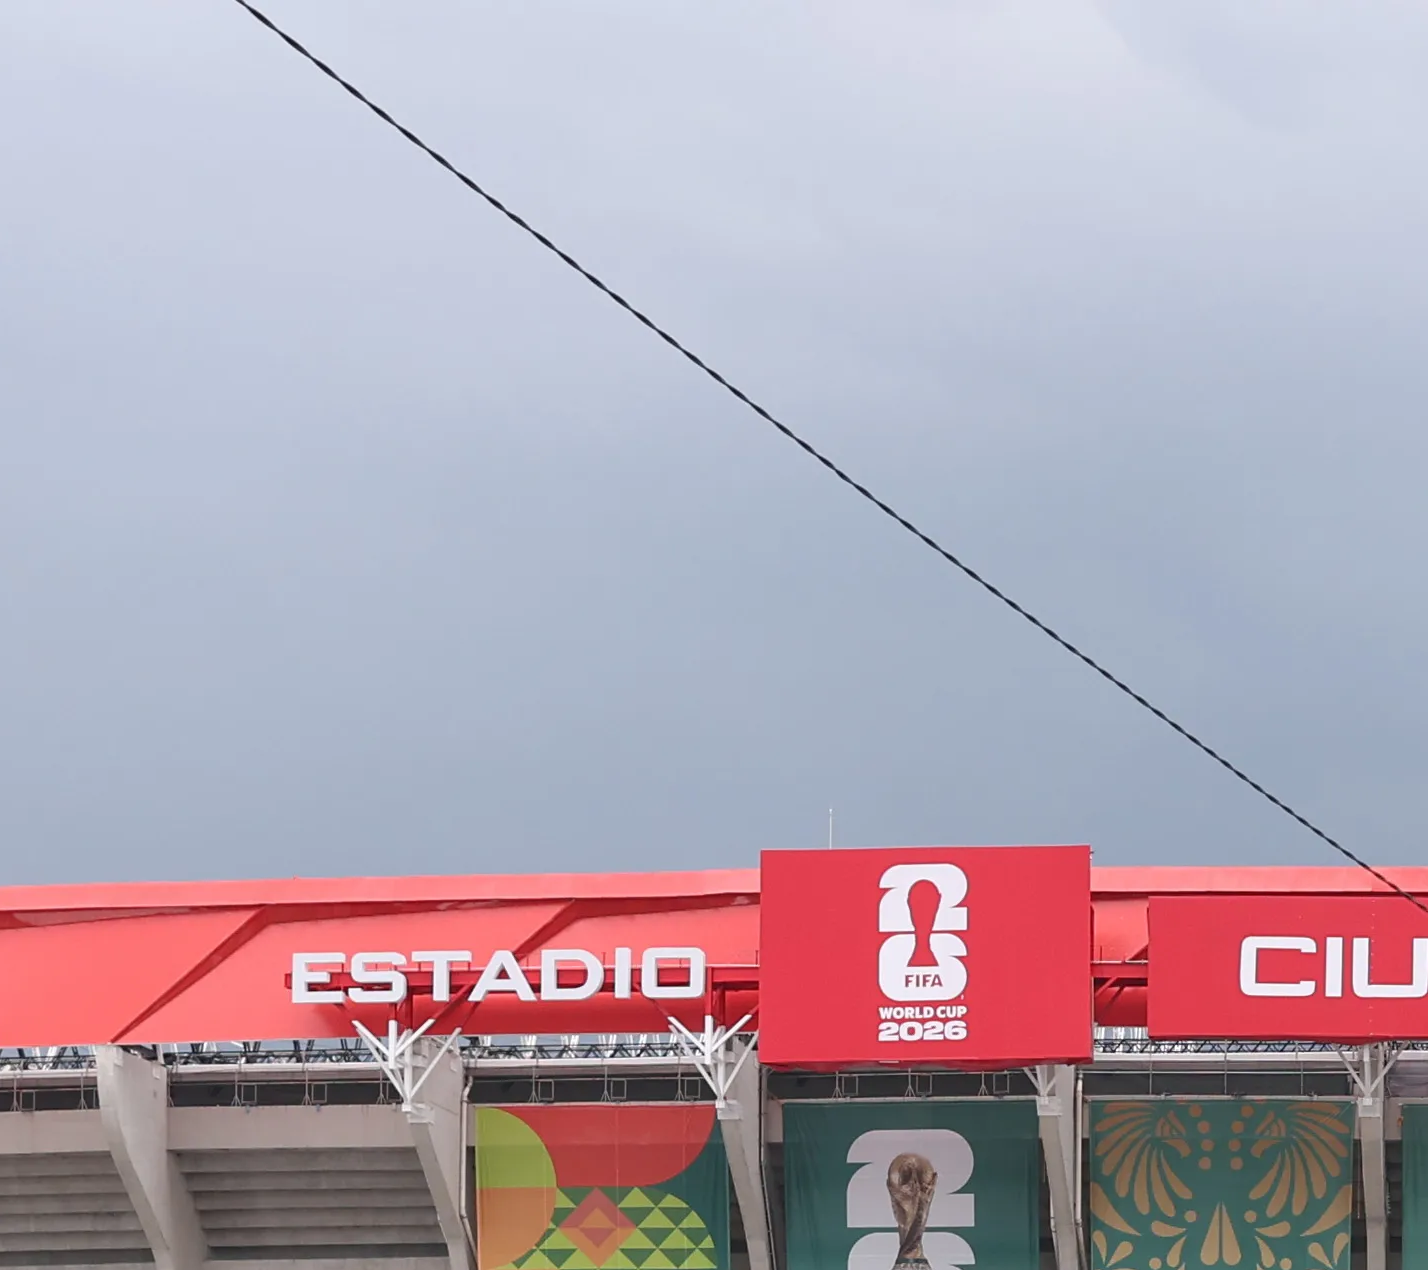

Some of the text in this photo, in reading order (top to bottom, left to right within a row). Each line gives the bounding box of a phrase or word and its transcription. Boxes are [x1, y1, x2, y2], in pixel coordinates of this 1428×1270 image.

[291, 947, 707, 1004] ESTADIO
[903, 973, 944, 989] FIFA
[878, 1006, 968, 1021] WORLD CUP
[878, 1021, 968, 1042] 2026
